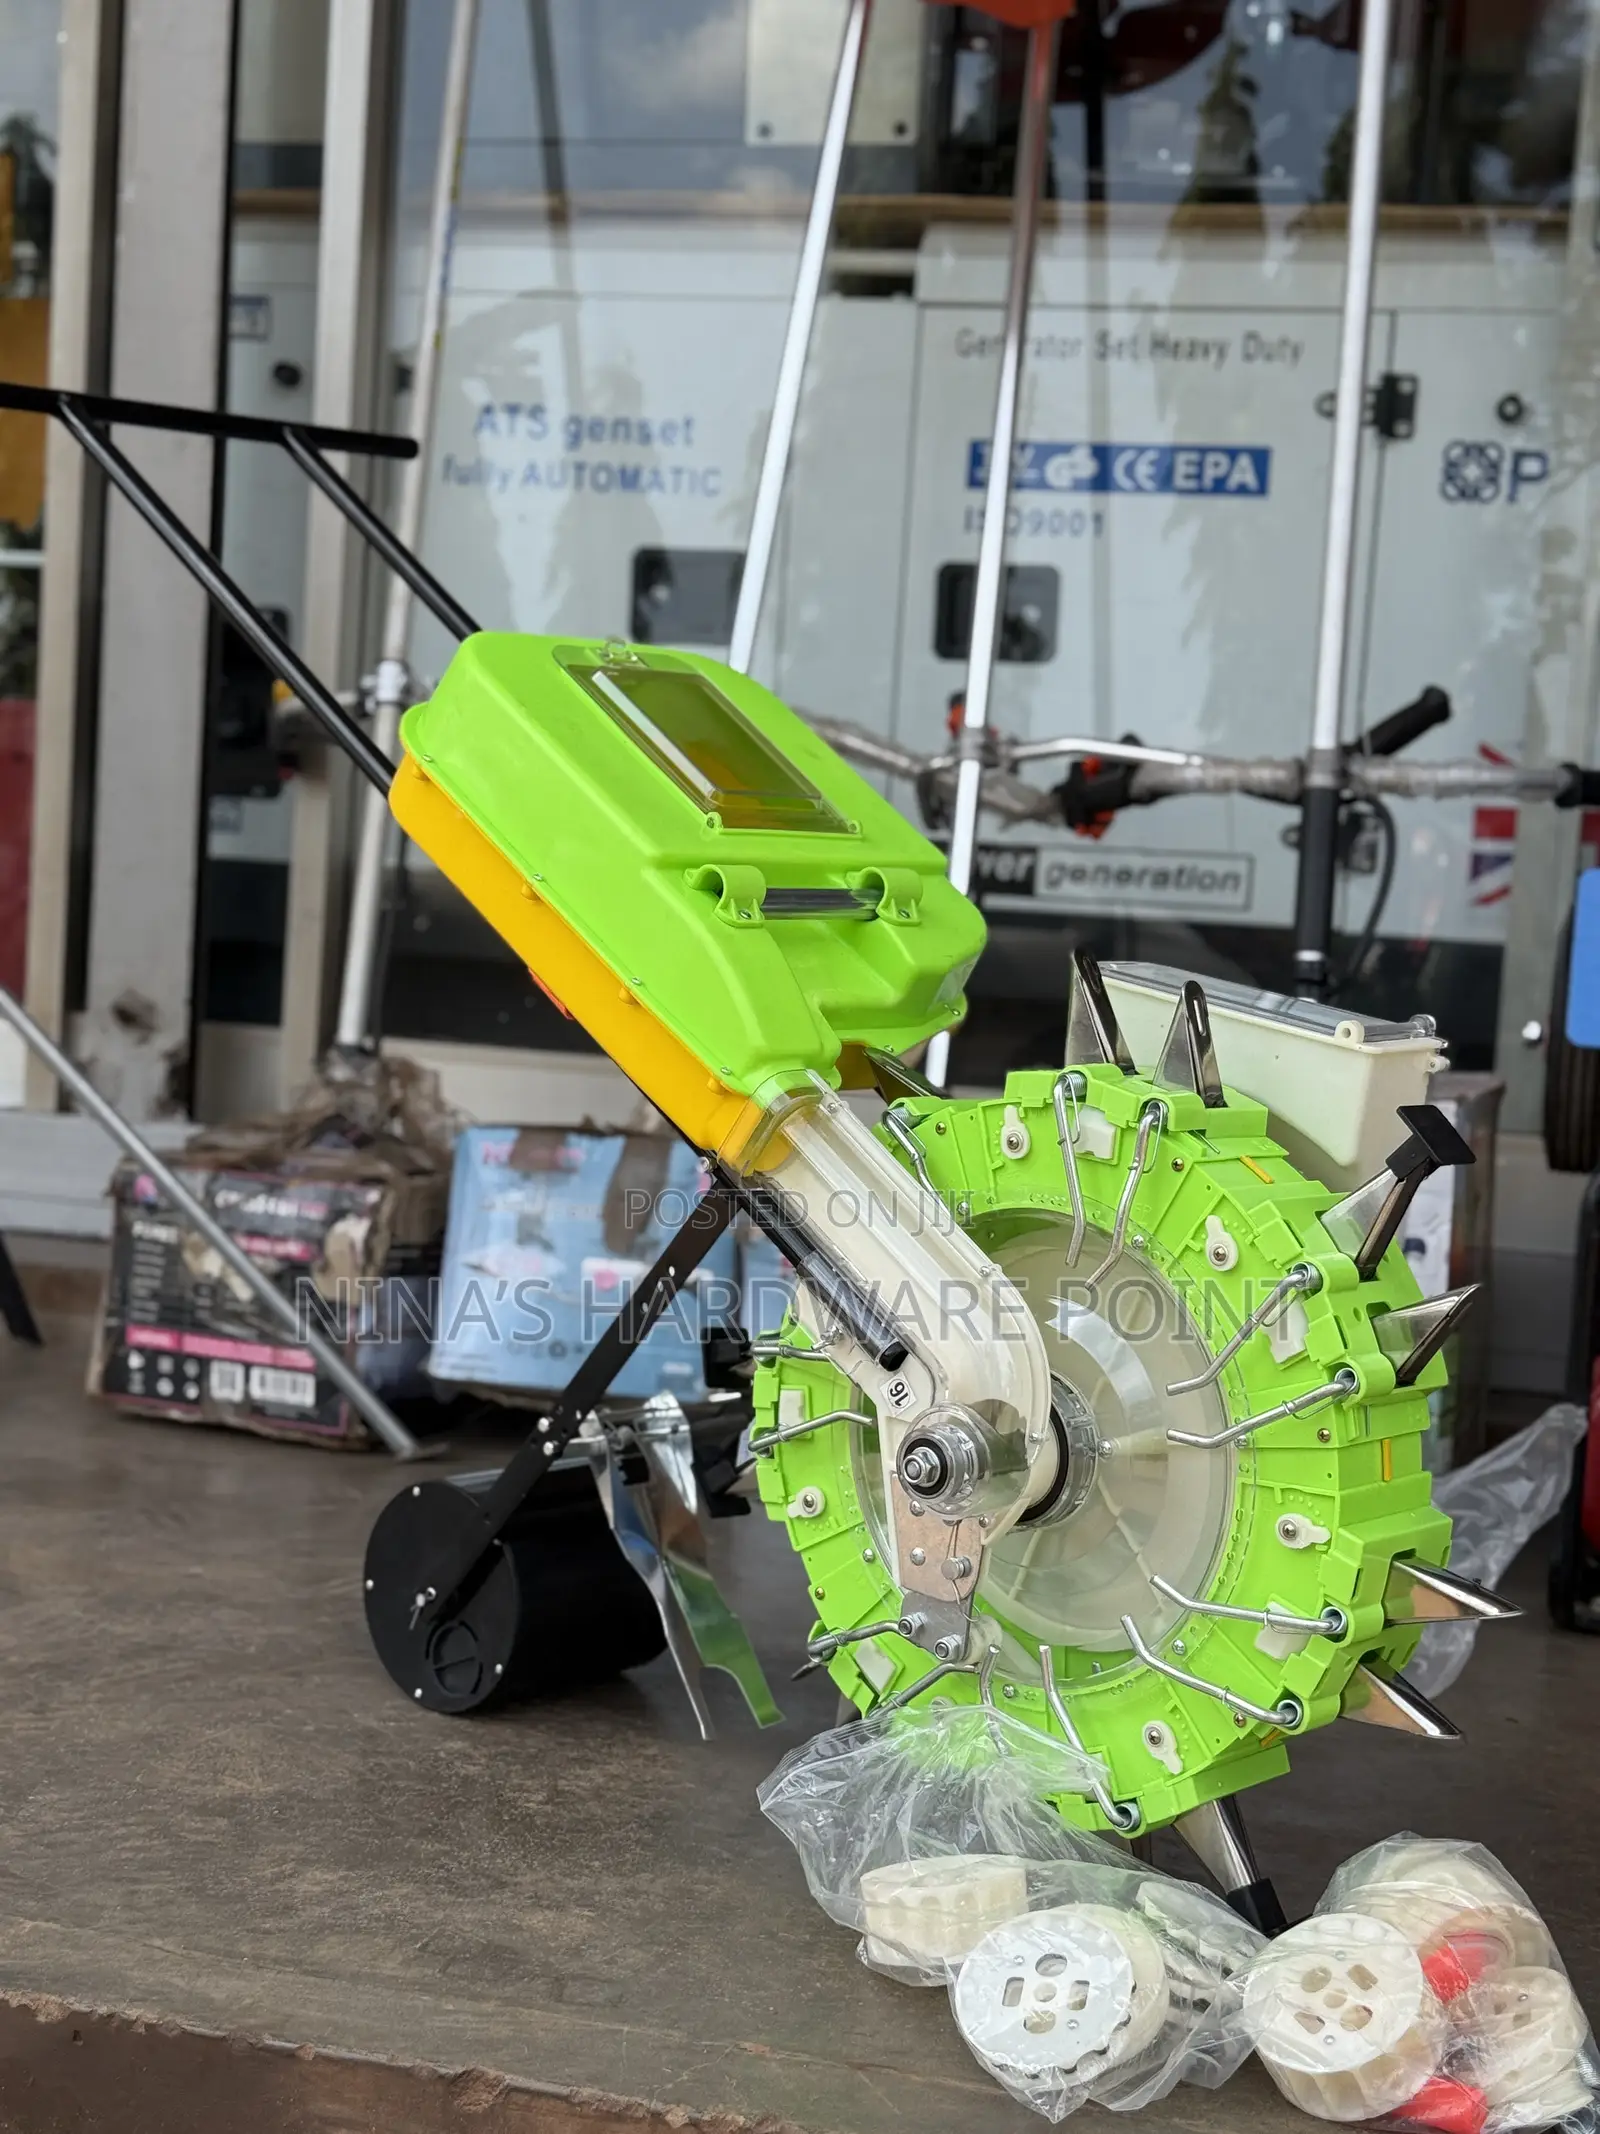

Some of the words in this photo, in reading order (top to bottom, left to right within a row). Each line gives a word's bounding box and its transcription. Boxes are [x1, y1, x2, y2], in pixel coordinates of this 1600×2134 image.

[1094, 329, 1140, 362] Set
[1148, 331, 1233, 371] Heavy
[1240, 330, 1305, 371] Duty
[474, 403, 549, 440] ATS
[564, 414, 695, 451] genset
[442, 453, 514, 494] fully
[521, 459, 722, 498] AUTOMATIC
[1173, 450, 1261, 492] EPA
[1044, 861, 1244, 893] generation
[889, 1381, 909, 1407] 16
